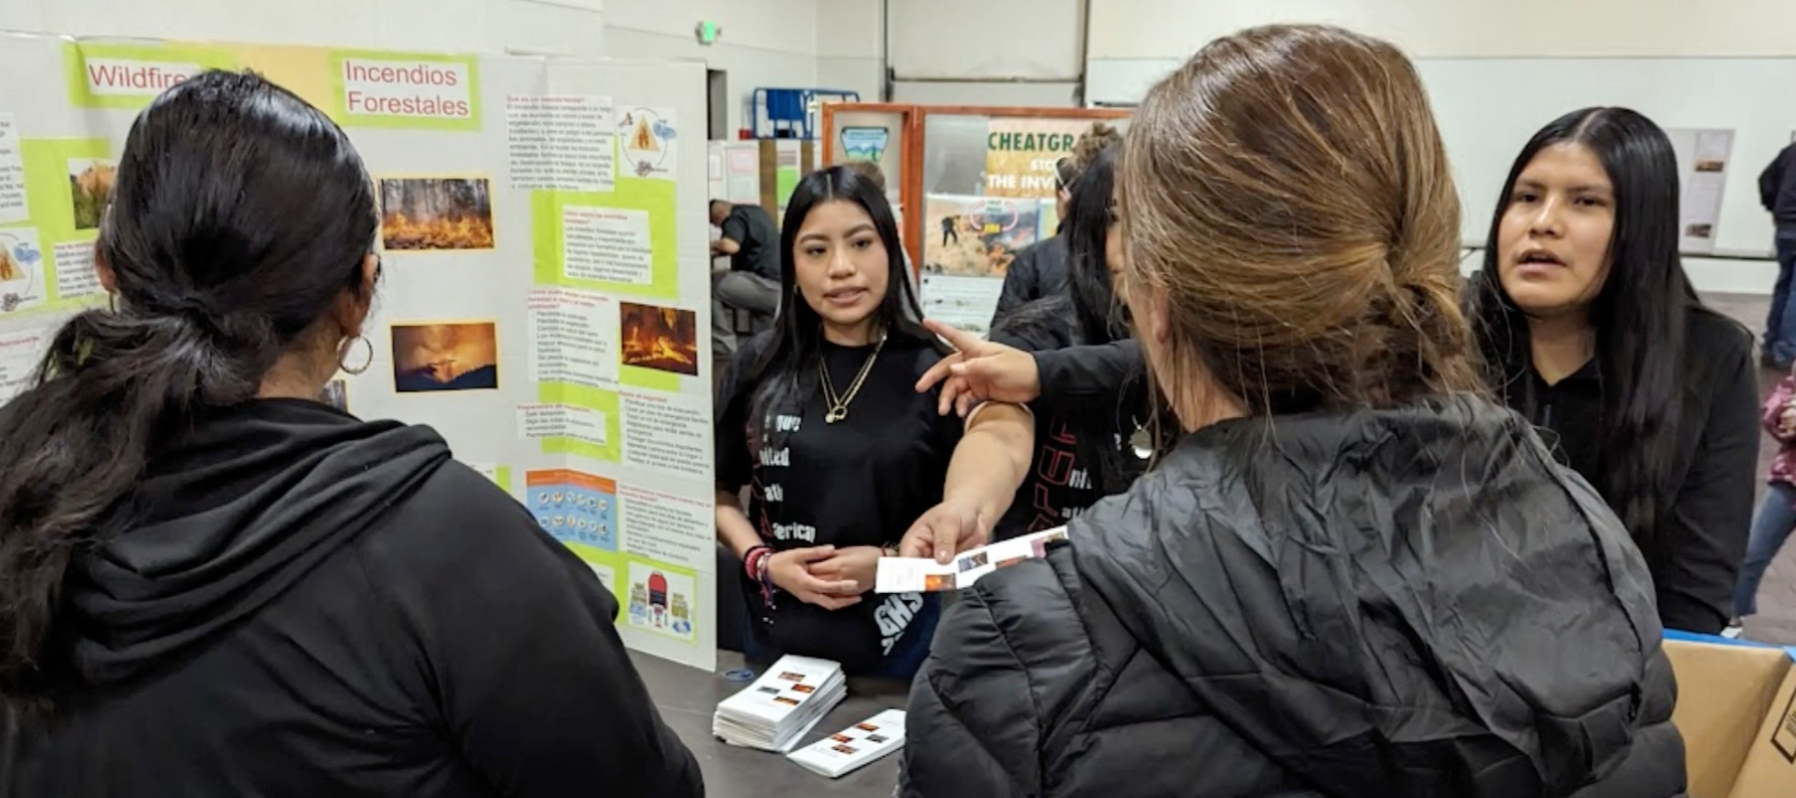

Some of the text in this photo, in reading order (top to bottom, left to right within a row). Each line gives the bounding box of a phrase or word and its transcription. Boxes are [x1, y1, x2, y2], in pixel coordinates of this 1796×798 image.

[88, 64, 188, 89] Wildfire
[346, 60, 457, 86] Incendios
[348, 91, 469, 116] Forestales
[987, 132, 1074, 151] CHEATGR
[988, 175, 1016, 189] THE
[873, 592, 924, 637] GHS
